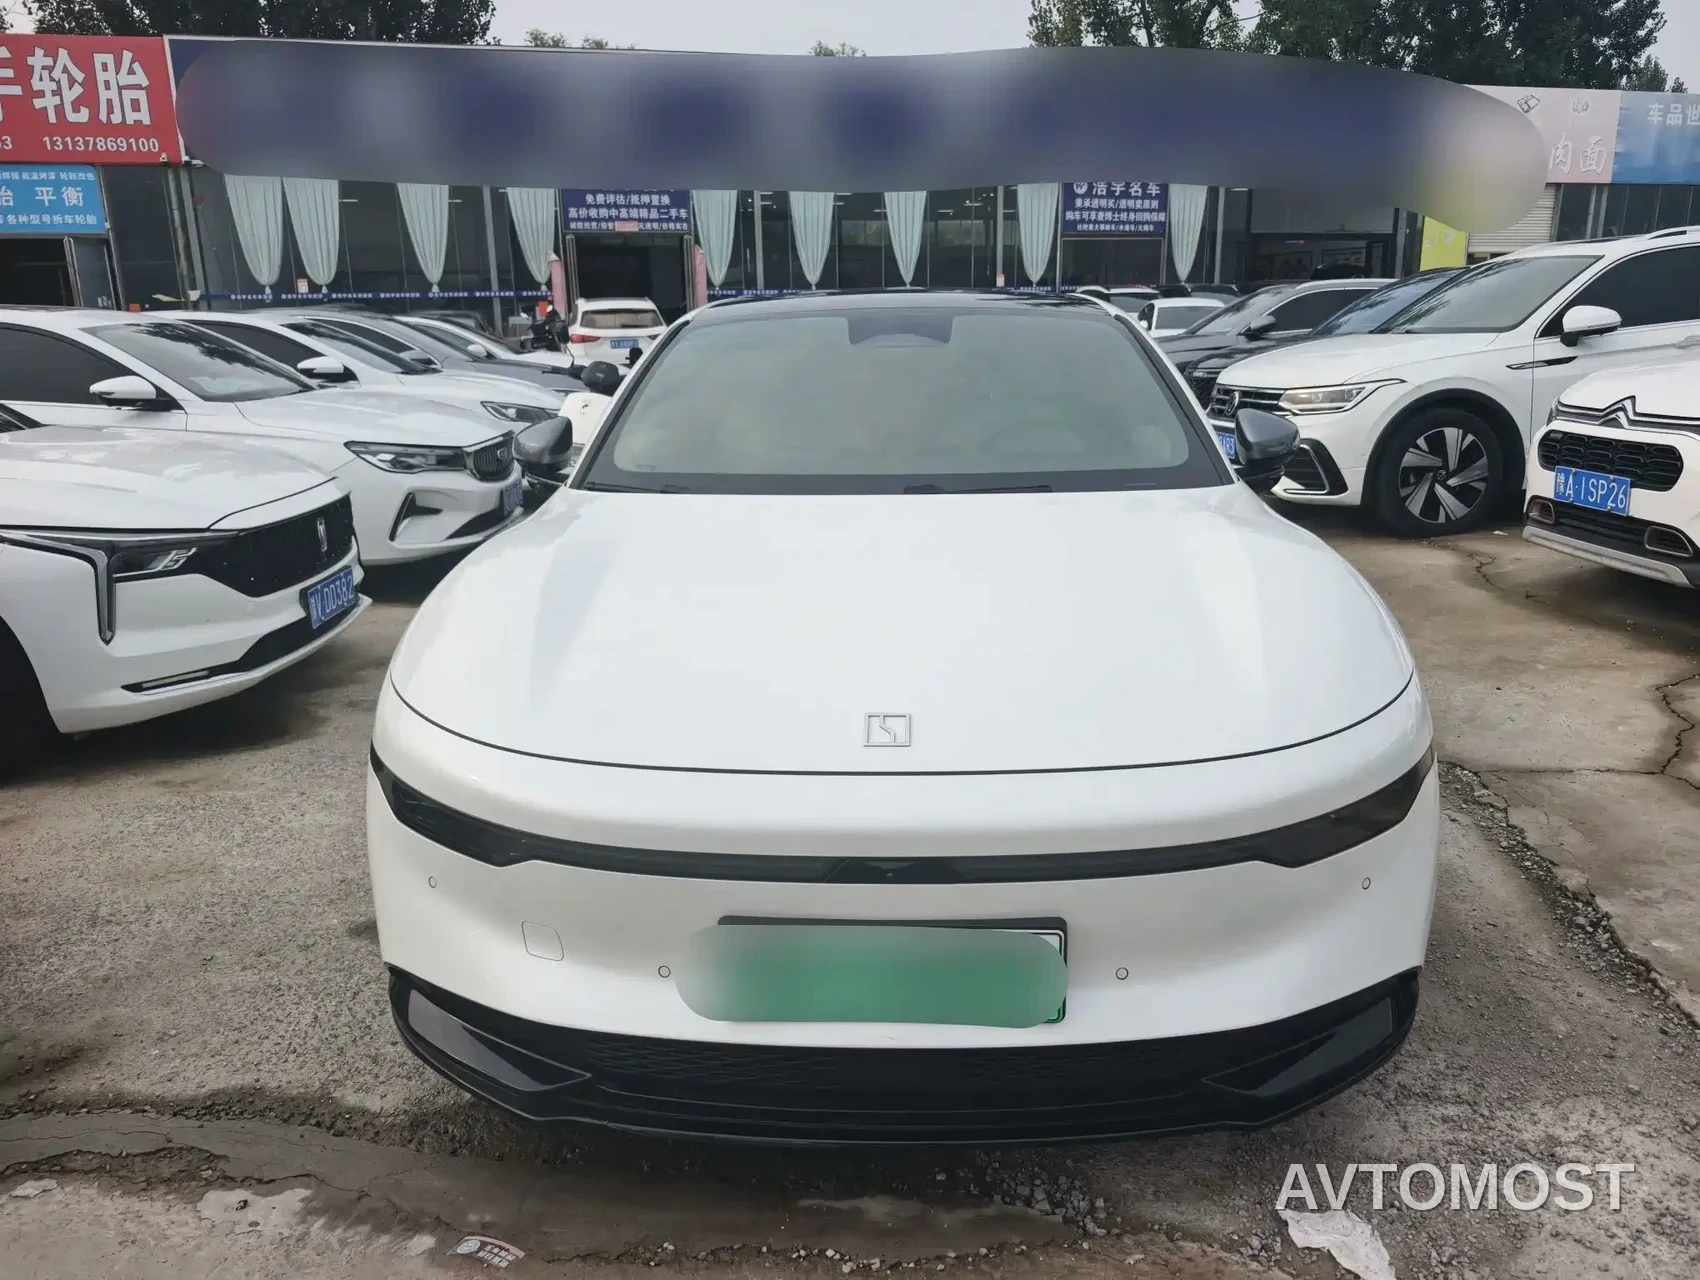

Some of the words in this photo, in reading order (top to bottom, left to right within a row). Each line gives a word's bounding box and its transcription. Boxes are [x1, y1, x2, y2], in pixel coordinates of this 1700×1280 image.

[43, 136, 159, 152] 13137869100
[1549, 133, 1607, 176] 肉面
[34, 186, 84, 207] 平衡
[585, 193, 671, 206] 免费评估/抵押置换
[7, 213, 97, 225] 各种型号拆车轮胎
[568, 207, 689, 220] 高价收购中高端精品二手车
